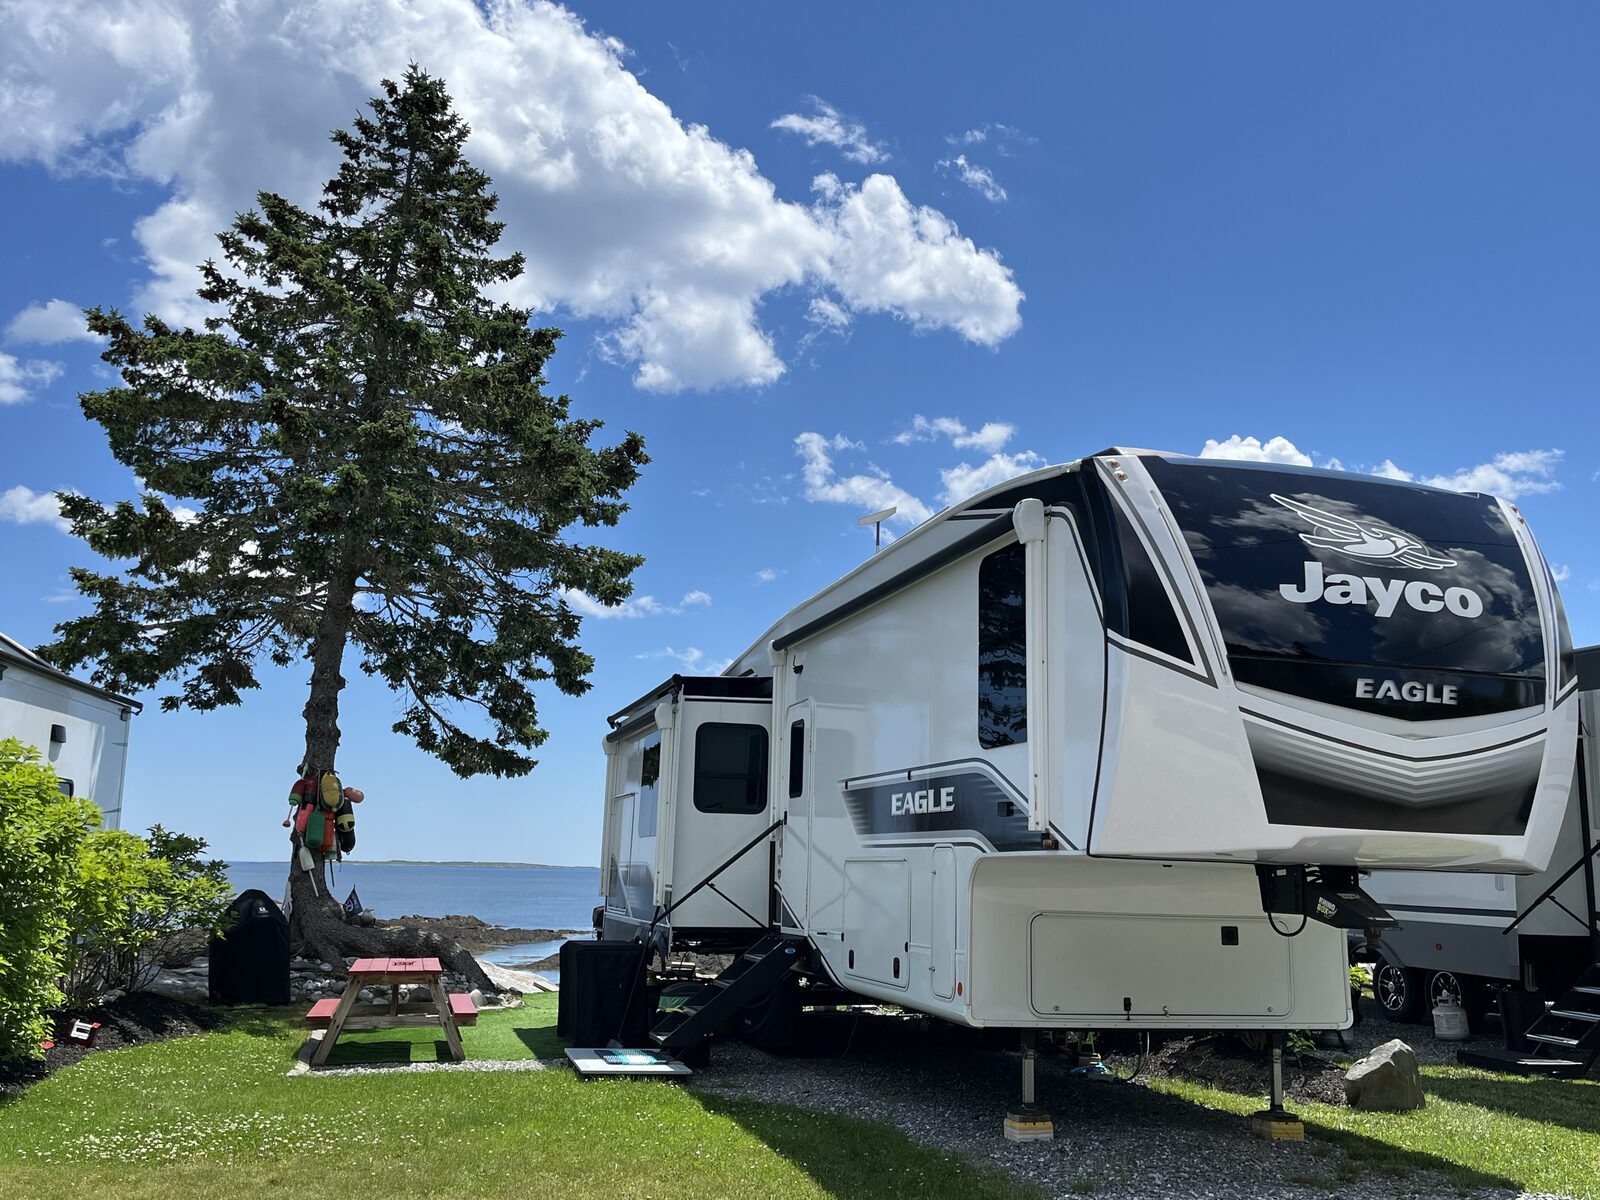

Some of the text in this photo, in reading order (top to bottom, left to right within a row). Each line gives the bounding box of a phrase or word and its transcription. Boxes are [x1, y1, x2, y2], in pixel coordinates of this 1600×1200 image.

[1279, 561, 1483, 618] Jayco
[1355, 678, 1458, 705] EAGLE
[891, 786, 955, 816] EAGLE
